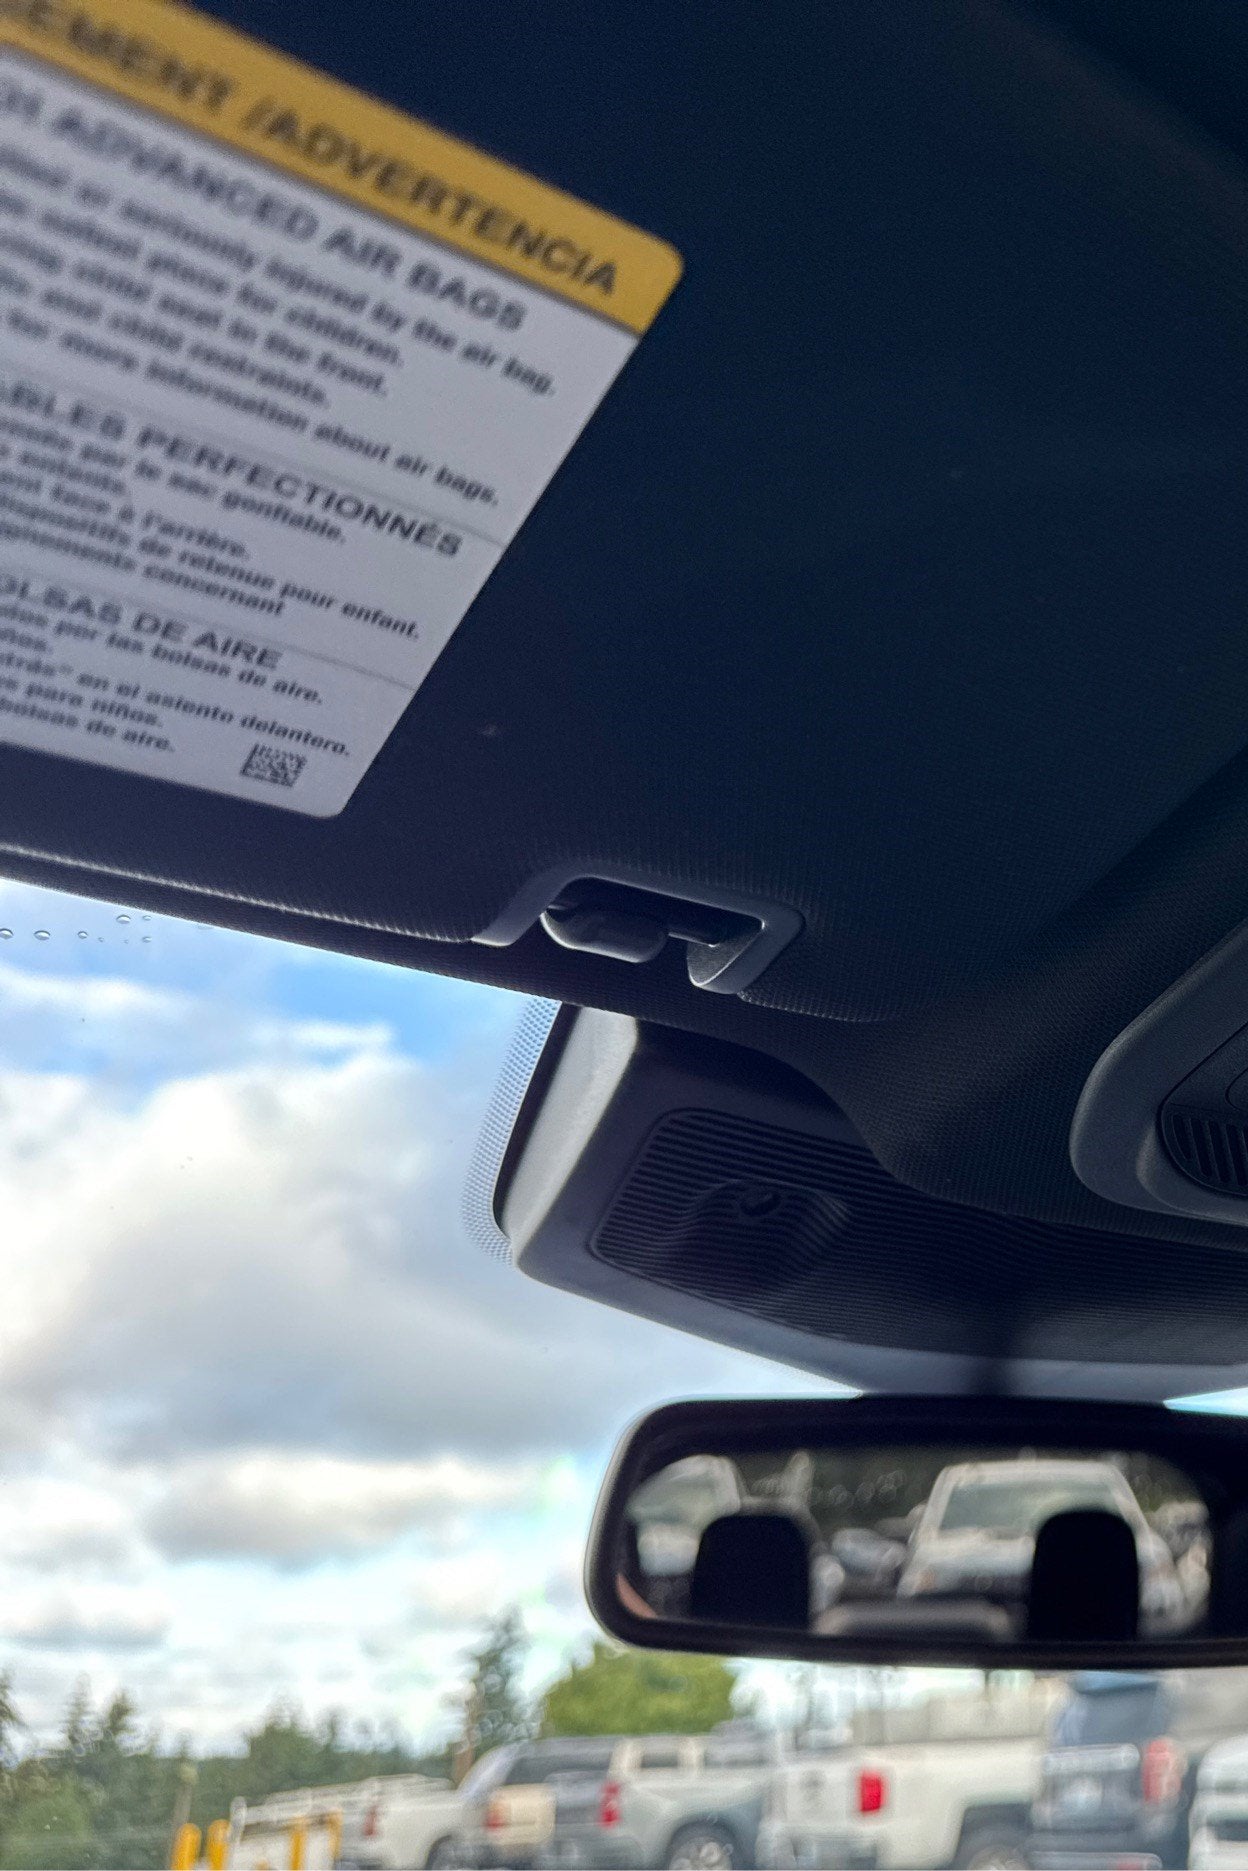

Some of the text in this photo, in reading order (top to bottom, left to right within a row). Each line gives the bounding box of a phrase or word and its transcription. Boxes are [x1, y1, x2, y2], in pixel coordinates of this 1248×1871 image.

[50, 105, 318, 240] ADVANCED
[322, 227, 402, 277] AIR
[406, 260, 528, 332] BAGS
[240, 95, 622, 297] /ADVERTENCIA
[147, 250, 230, 297] place
[236, 280, 278, 312] for
[284, 304, 403, 367] children.
[157, 294, 223, 330] seat
[228, 316, 258, 344] in
[264, 329, 311, 364] the
[316, 350, 388, 397] front.
[264, 254, 370, 314] injured
[368, 300, 405, 334] by
[411, 317, 457, 351] the
[460, 340, 498, 369] air
[501, 354, 555, 397] bag.
[188, 340, 330, 407] restraints.
[145, 357, 309, 430] information
[314, 420, 391, 464] about
[394, 451, 430, 478] air
[433, 462, 499, 508] bags.
[51, 482, 112, 516] face
[134, 456, 164, 484] le
[166, 470, 220, 500] sac
[221, 487, 347, 546] gonflable.
[135, 424, 461, 556] PERFECTIONNÉS
[138, 537, 172, 559] de
[177, 550, 275, 592] retenue
[279, 581, 336, 610] pour
[339, 601, 419, 640] enfant.
[143, 562, 284, 618] concernant
[54, 619, 98, 644] por
[106, 631, 144, 654] las
[151, 642, 231, 678] bolsas
[237, 668, 267, 688] de
[272, 679, 322, 706] aire.
[132, 611, 188, 644] DE
[191, 630, 284, 672] AIRE
[25, 681, 83, 708] para
[90, 698, 163, 728] niños.
[77, 671, 110, 692] en
[116, 681, 140, 699] el
[146, 690, 234, 724] asiento
[240, 714, 350, 757] delantero.
[85, 718, 117, 739] de
[121, 728, 175, 754] aire.
